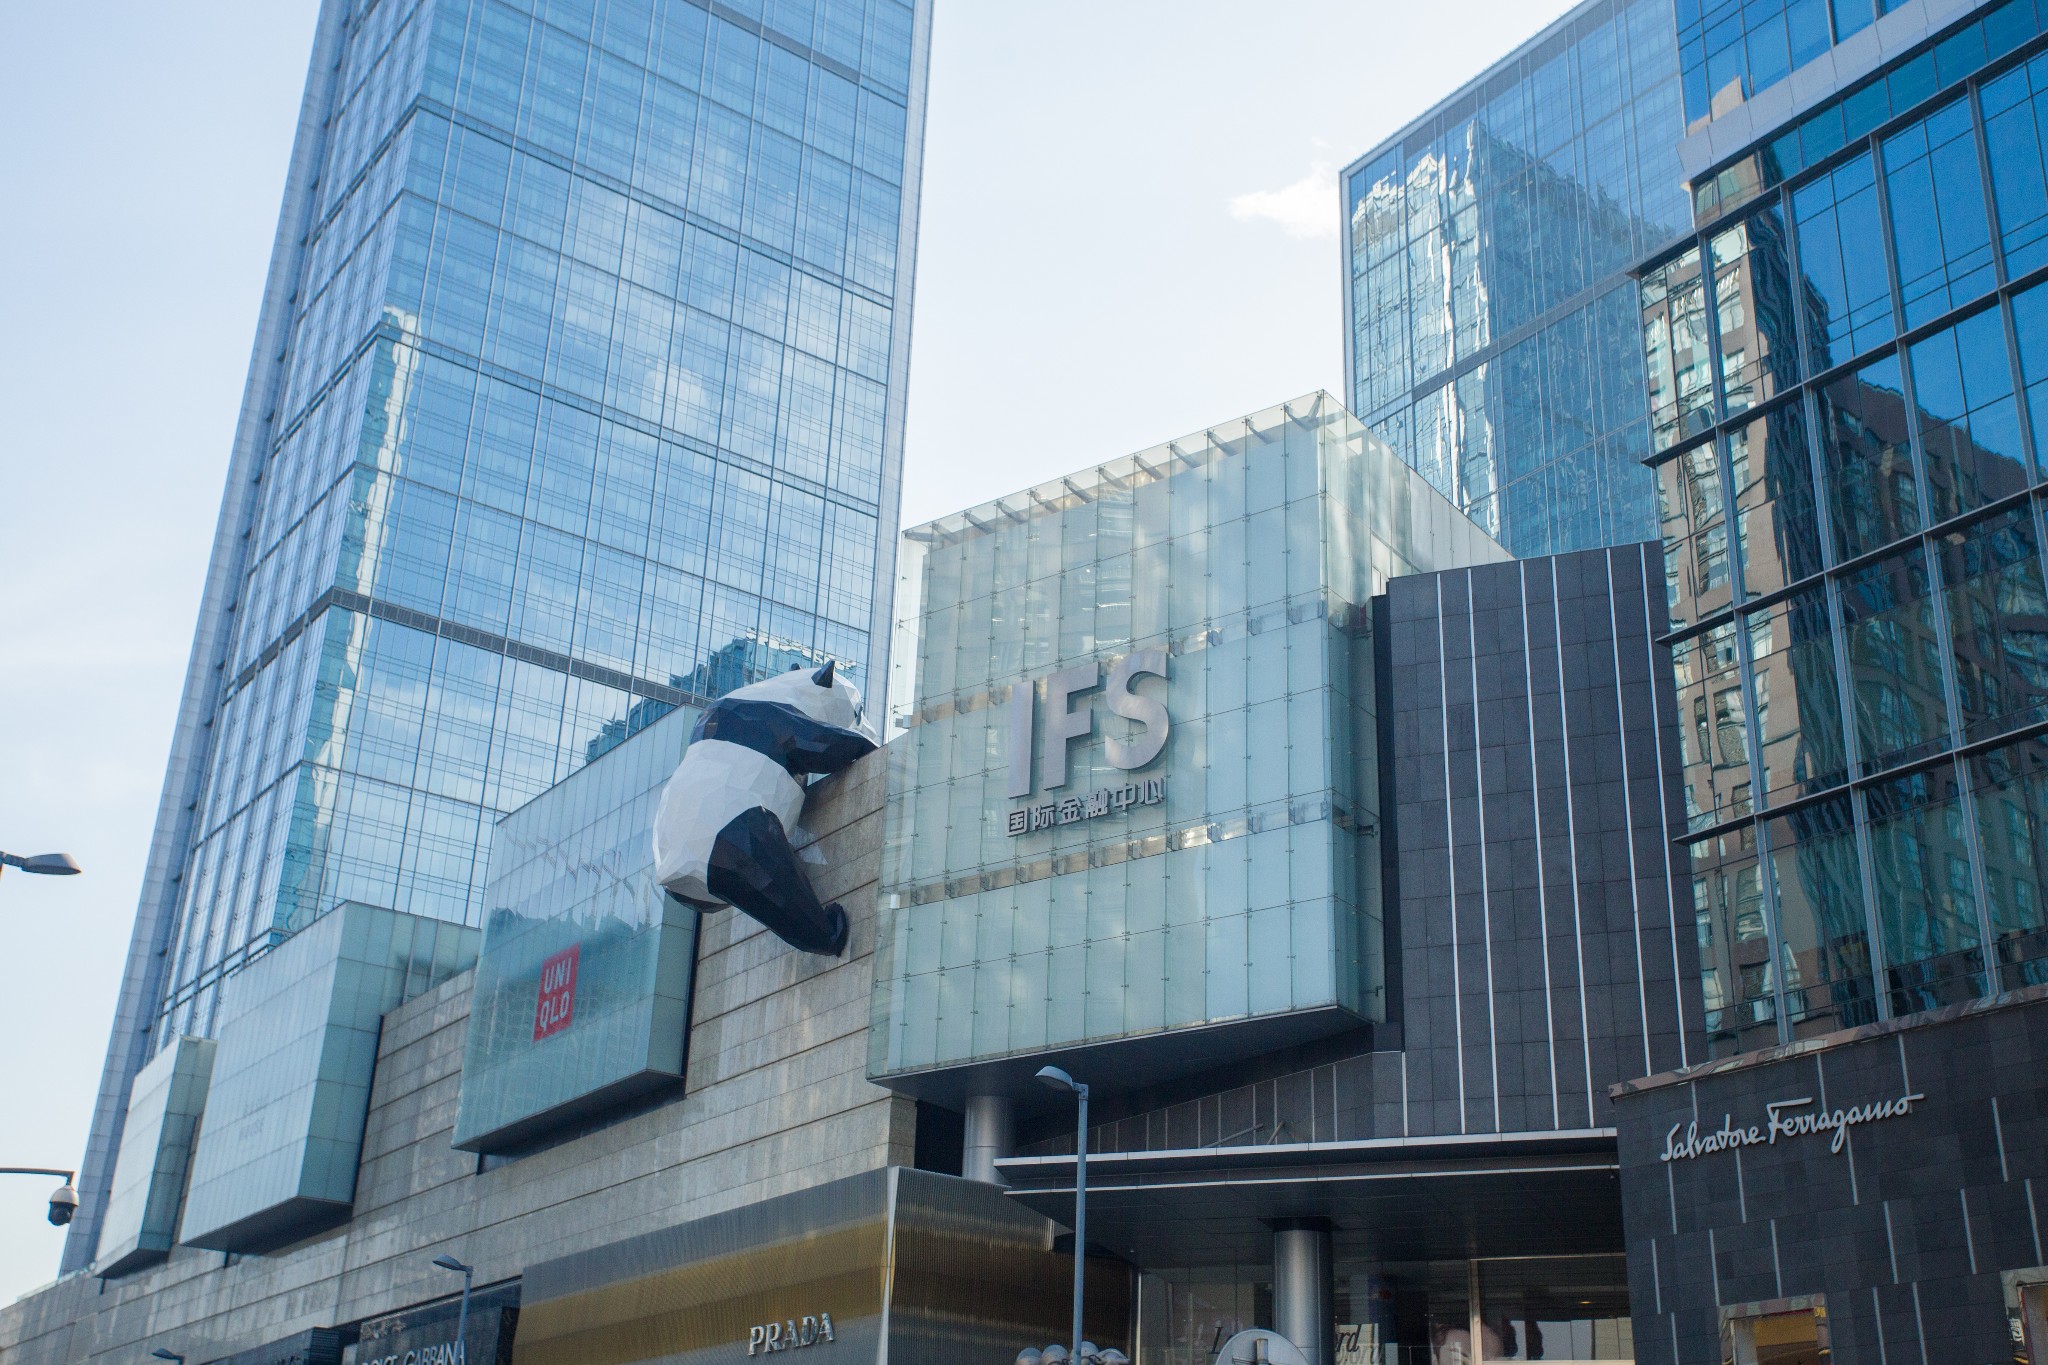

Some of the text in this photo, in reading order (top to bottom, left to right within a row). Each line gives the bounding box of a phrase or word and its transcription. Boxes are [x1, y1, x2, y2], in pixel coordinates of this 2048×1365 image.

[1008, 651, 1169, 799] IFS
[1007, 778, 1166, 837] 国际金融中心
[544, 957, 572, 994] UNI
[540, 991, 570, 1032] QLO
[1660, 1093, 1925, 1162] Salvatore Ferragamo
[747, 1312, 834, 1356] PRADA
